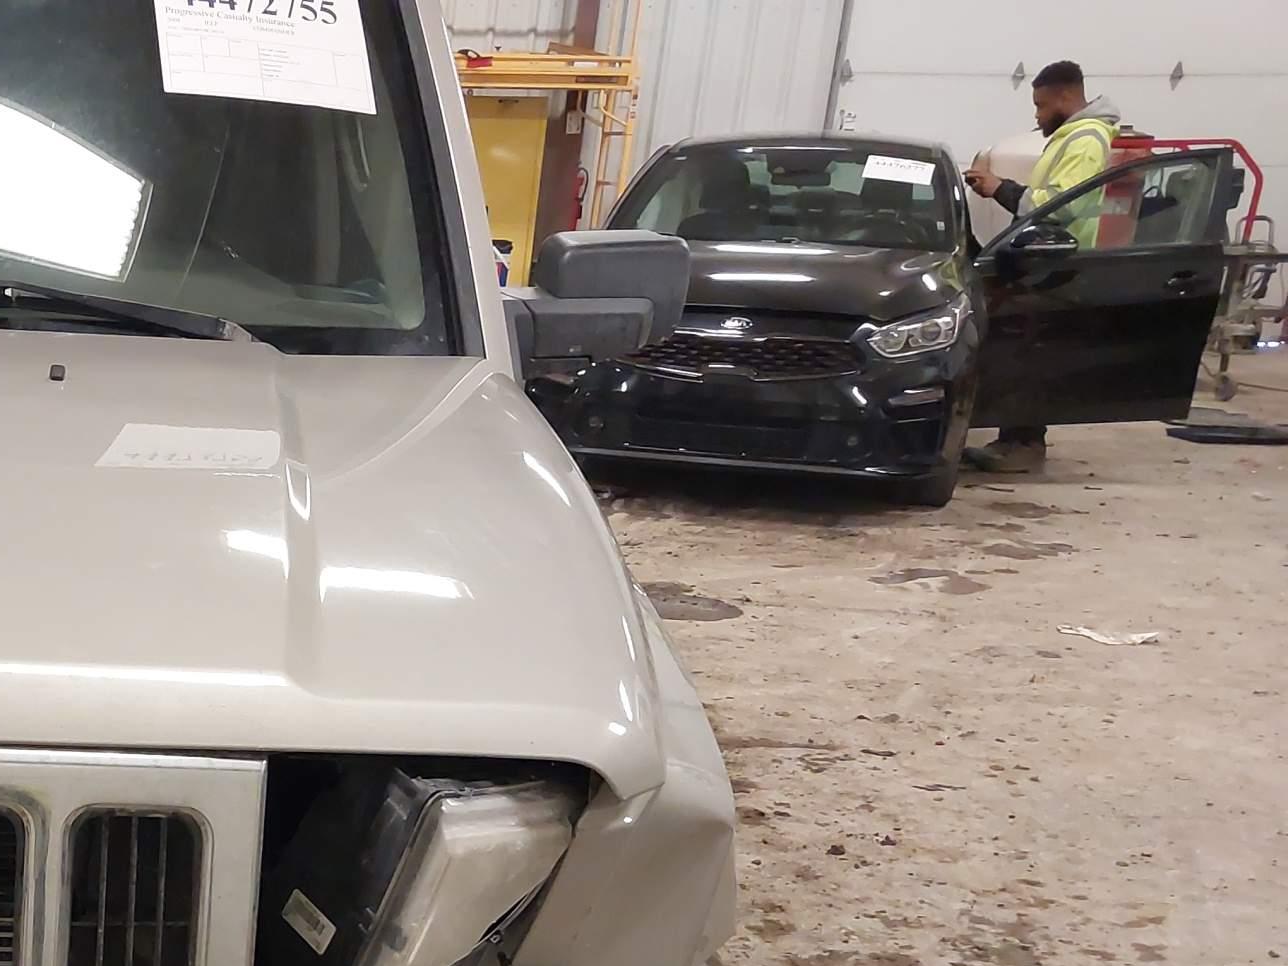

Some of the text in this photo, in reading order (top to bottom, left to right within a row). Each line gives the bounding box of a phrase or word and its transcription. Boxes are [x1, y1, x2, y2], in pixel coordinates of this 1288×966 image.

[165, 7, 295, 28] Progressive Casualty Insurance
[186, 0, 337, 24] 72755
